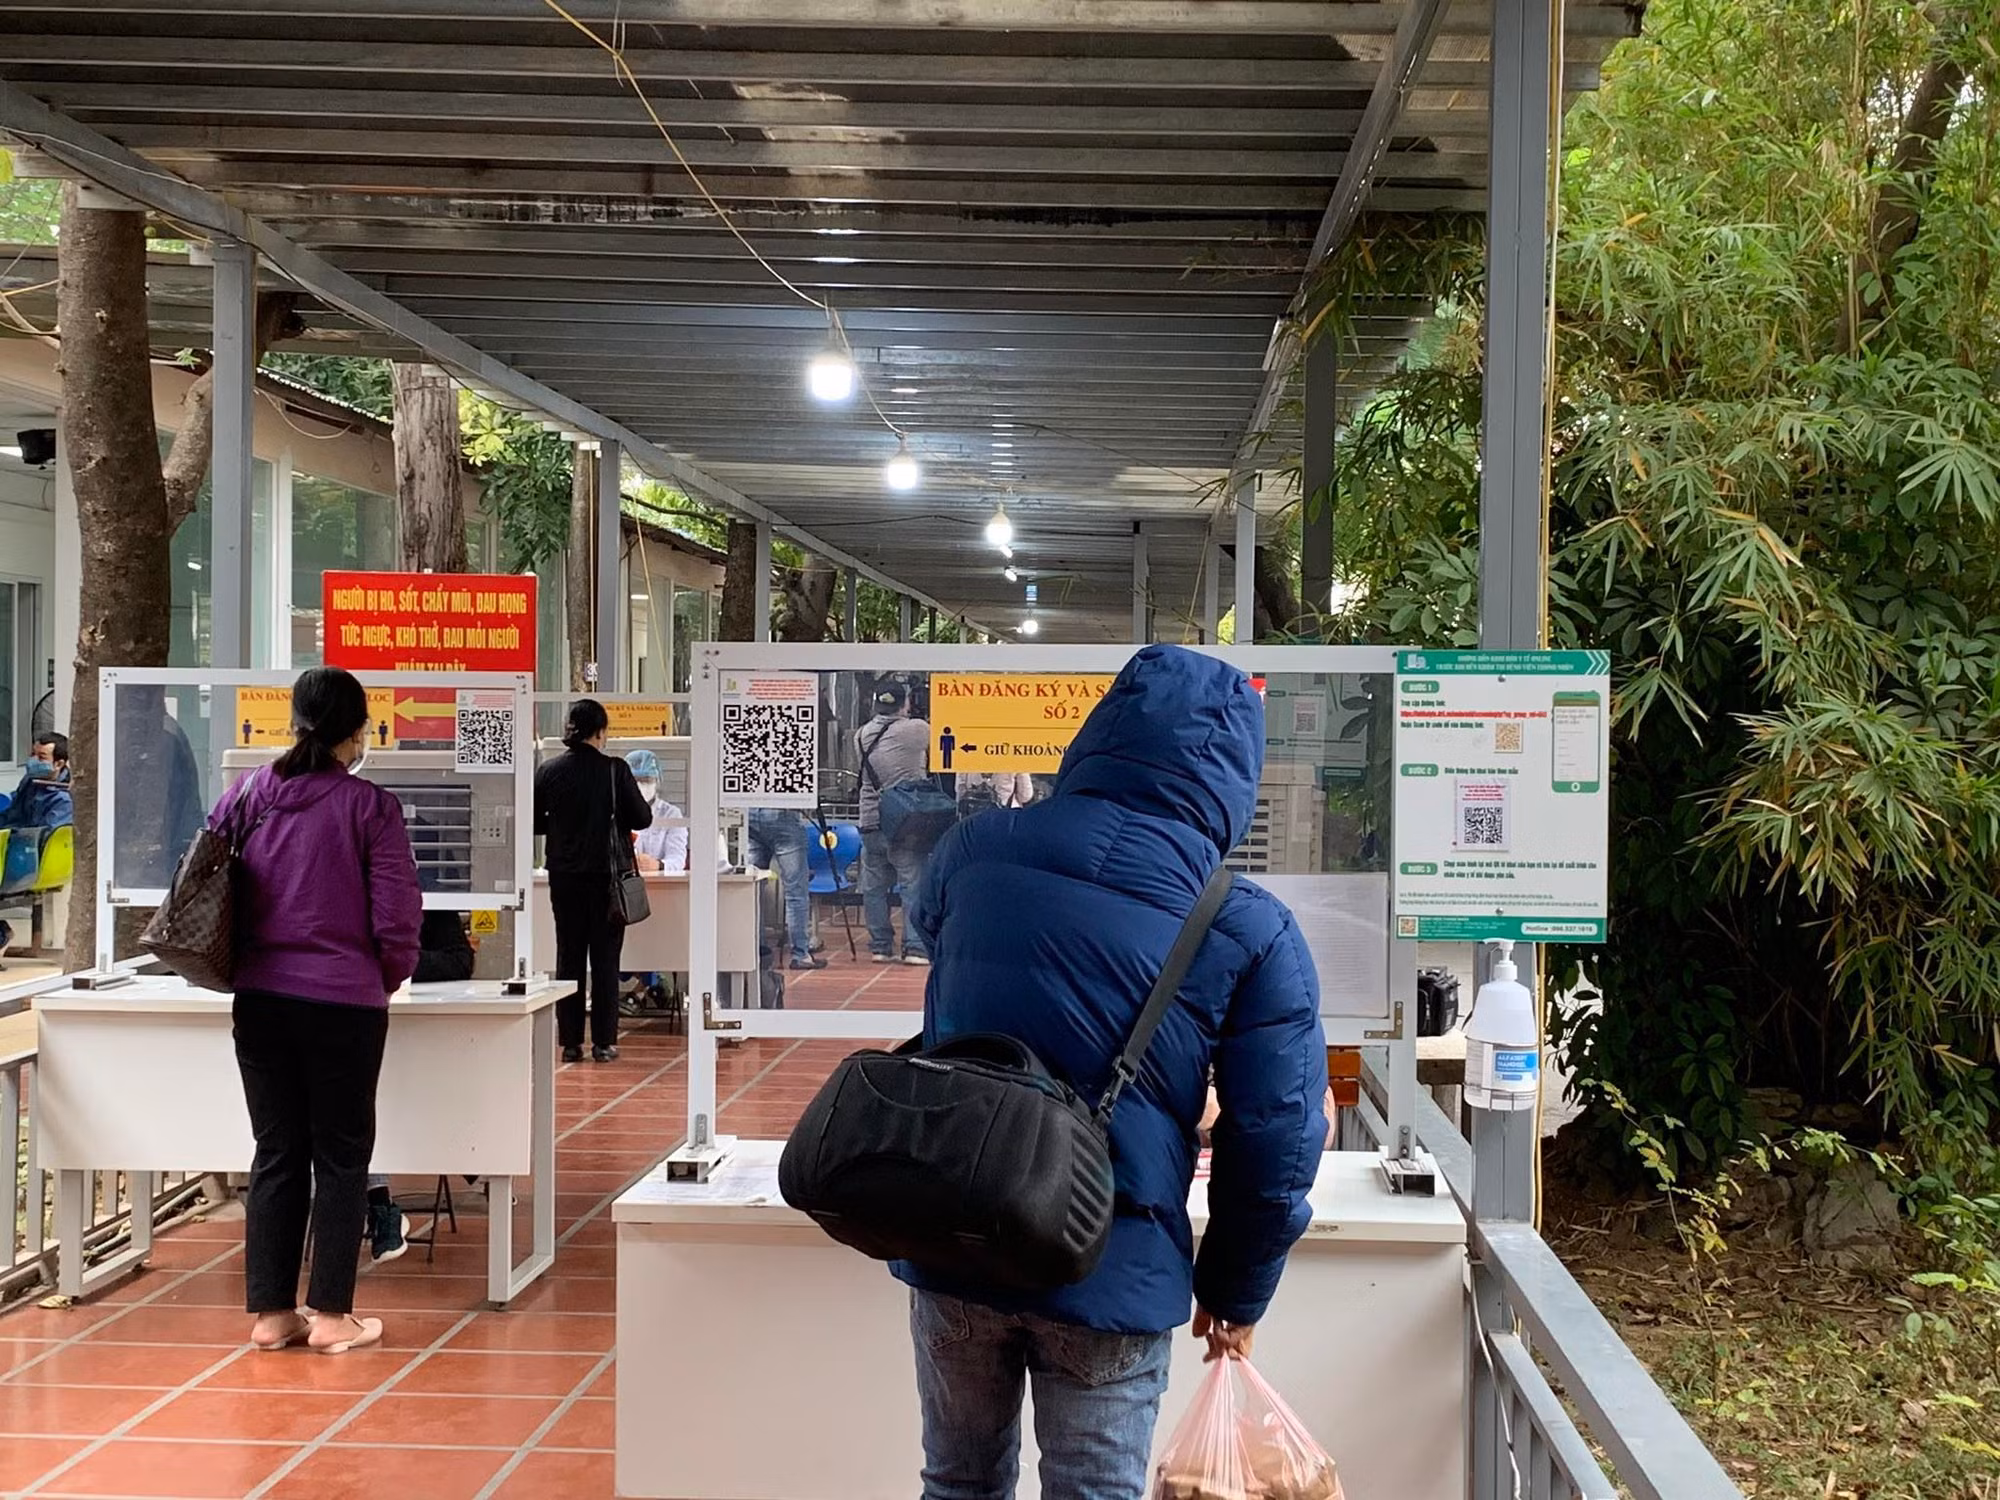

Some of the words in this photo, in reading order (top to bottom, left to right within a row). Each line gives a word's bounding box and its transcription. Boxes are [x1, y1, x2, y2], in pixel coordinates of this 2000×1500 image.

[332, 584, 365, 611] NGƯỜI
[367, 590, 379, 616] BỊ
[380, 590, 397, 613] HO,
[399, 583, 420, 614] SỐT,
[476, 592, 497, 613] ĐAU
[498, 593, 527, 618] HỌNG
[340, 621, 360, 646] TỨC
[362, 624, 394, 651] NGỰC,
[396, 622, 417, 647] KHÓ
[419, 620, 441, 650] THỞ,
[443, 627, 464, 648] ĐAU
[466, 621, 486, 649] MỎI
[488, 624, 520, 649] NGƯỜI
[240, 690, 263, 701] BÀN
[937, 679, 974, 697] BÀN
[979, 680, 1030, 698] ĐĂNG
[1035, 680, 1061, 697] KÝ
[1066, 680, 1090, 697] VÀ
[1043, 700, 1067, 719] SỐ
[1071, 706, 1080, 719] 2
[984, 742, 1010, 756] GIỮ
[1013, 742, 1069, 756] KHOẢN
